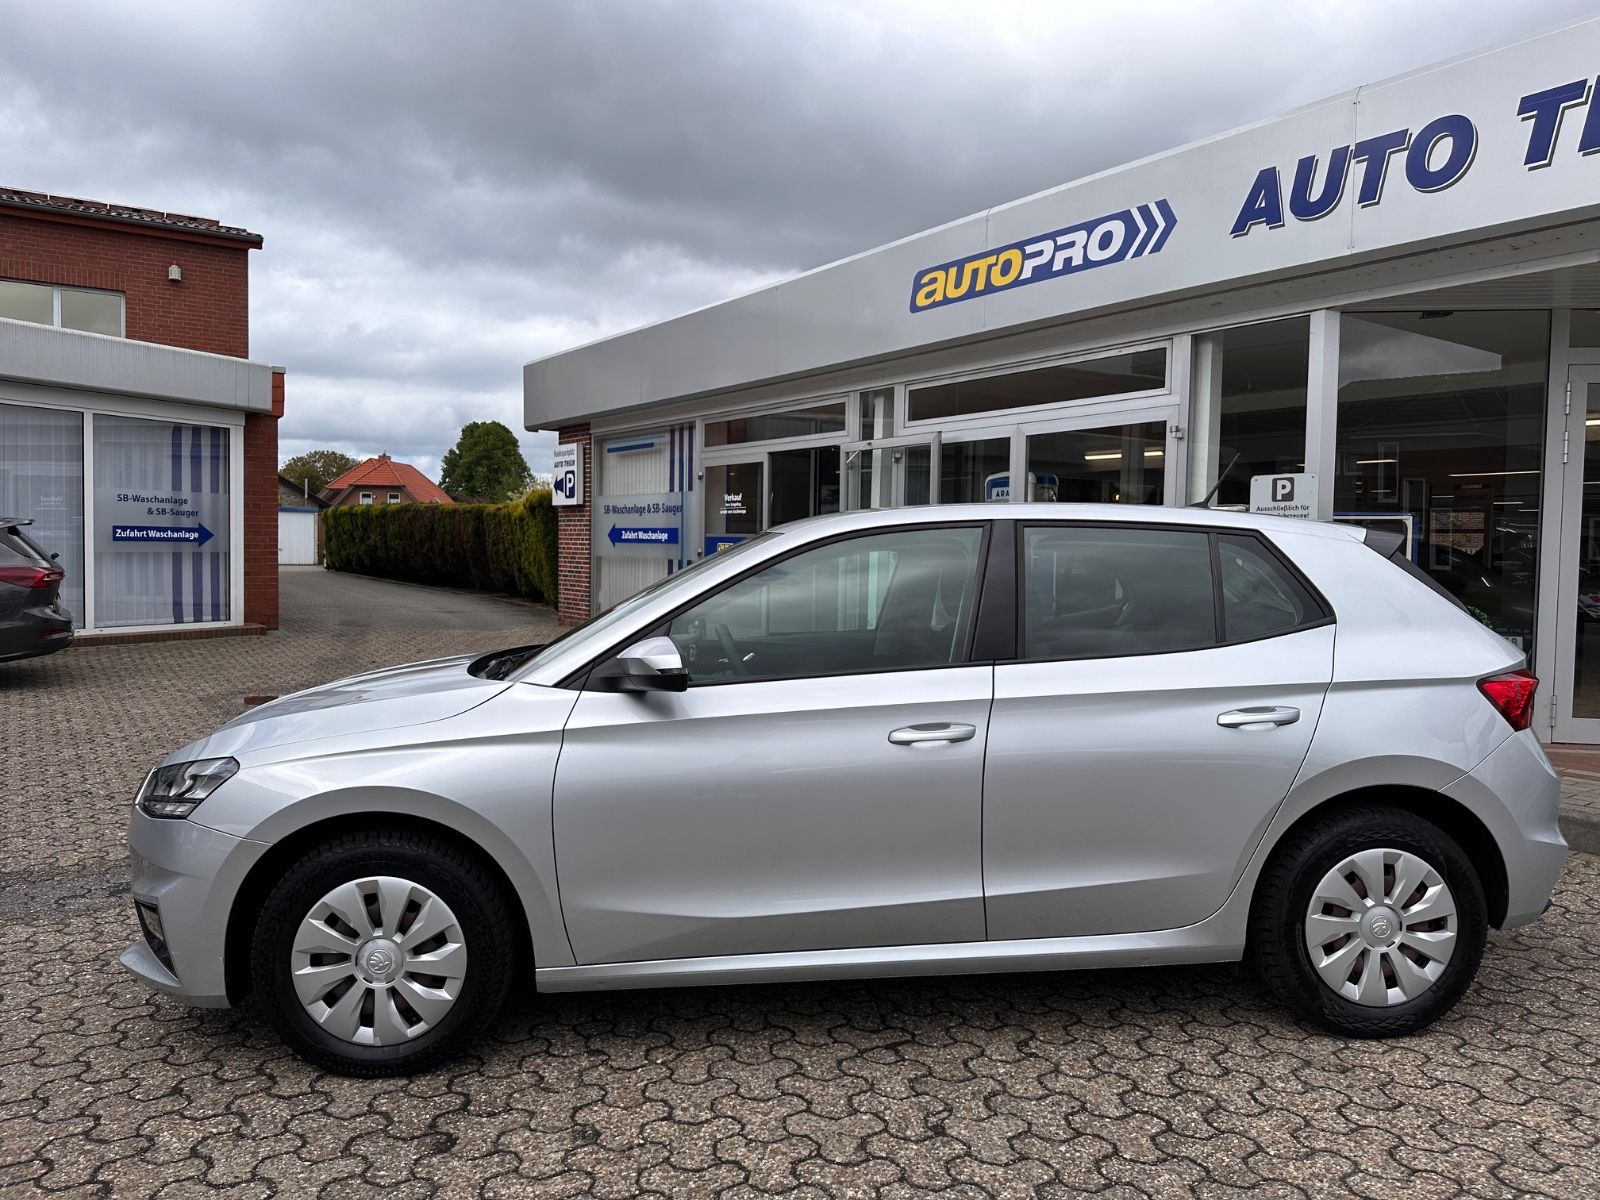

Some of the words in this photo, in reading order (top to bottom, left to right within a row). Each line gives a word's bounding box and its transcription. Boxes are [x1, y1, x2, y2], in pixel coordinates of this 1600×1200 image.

[1229, 114, 1478, 239] AUTO
[566, 473, 574, 497] P
[1276, 479, 1292, 500] P
[724, 492, 743, 502] Verkauf
[995, 489, 1009, 498] ARA
[117, 493, 188, 506] SB-Waschanlage
[147, 507, 154, 515] &
[155, 507, 200, 518] SB-Sauger
[603, 504, 646, 516] SB-Waschanlage
[646, 503, 651, 514] &
[652, 502, 683, 516] SB-Sauger
[1256, 504, 1300, 512] Ausschließlich
[115, 529, 147, 538] Zufahrt
[148, 530, 199, 540] Waschanlage
[621, 530, 638, 539] Zufahrt
[638, 530, 669, 541] Waschanlage
